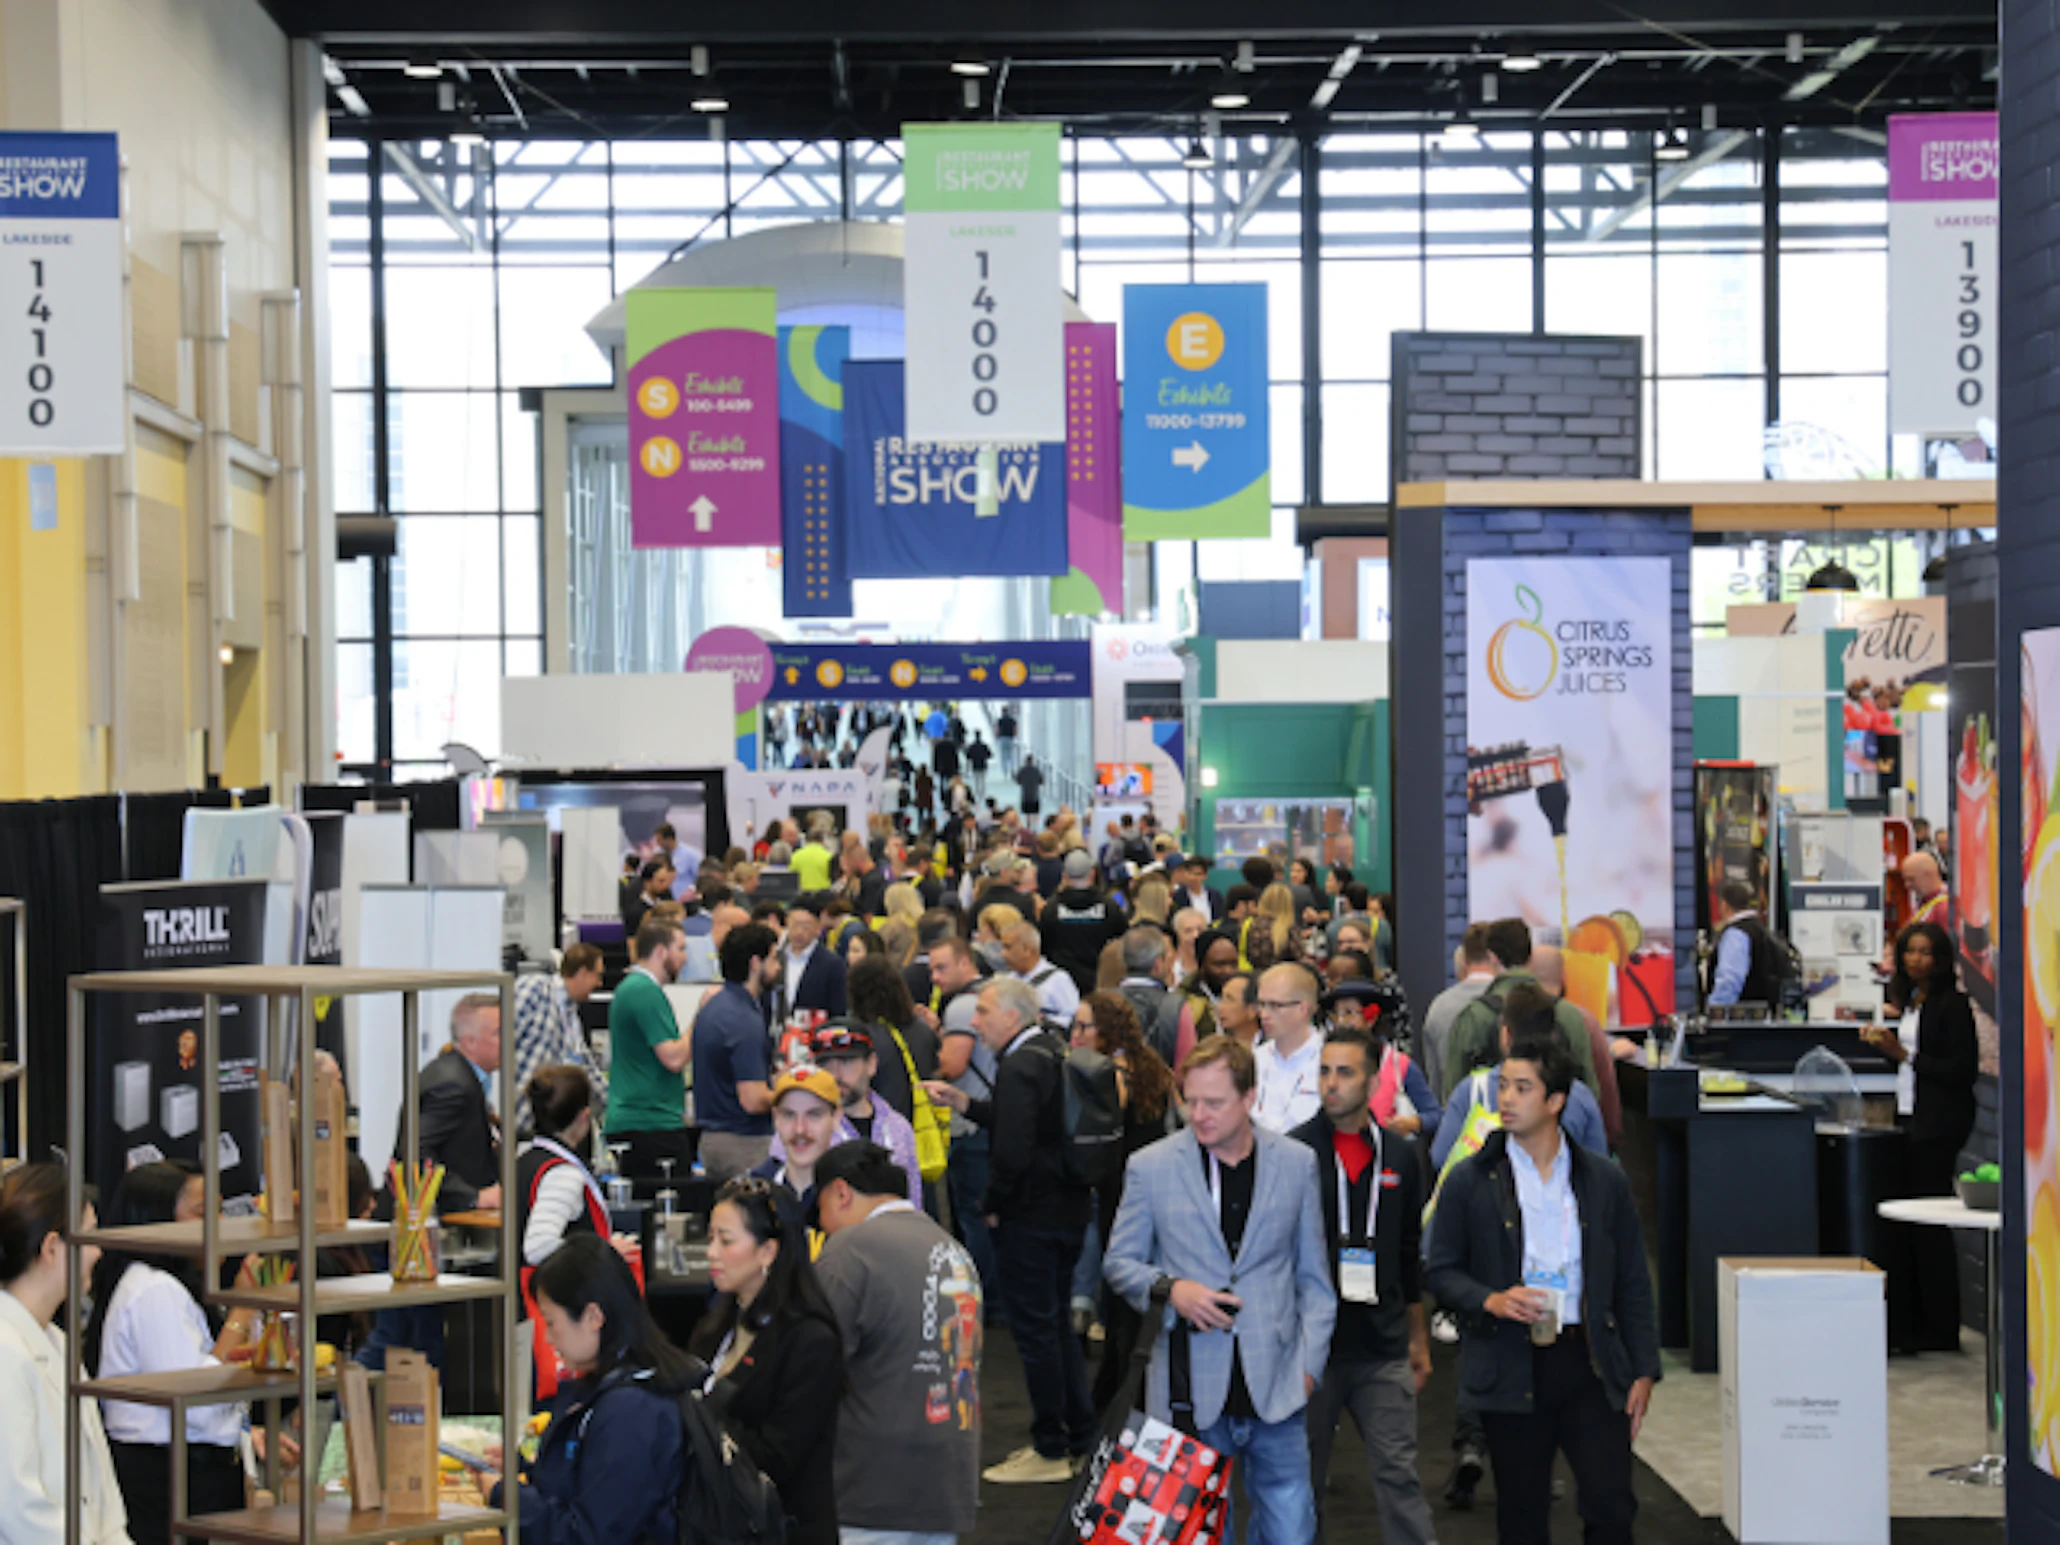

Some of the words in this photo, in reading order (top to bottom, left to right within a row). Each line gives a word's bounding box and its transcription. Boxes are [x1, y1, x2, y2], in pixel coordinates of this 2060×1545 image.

[943, 168, 1030, 192] SHOW
[3, 233, 73, 245] LAKESIDE
[948, 224, 1018, 238] LAKESIDE
[971, 250, 998, 417] 14000
[1956, 240, 1983, 407] 13900
[27, 258, 54, 428] 14100
[1181, 323, 1209, 358] E
[685, 372, 744, 394] Exhibits
[1158, 376, 1232, 407] Exhibits
[647, 384, 669, 411] S
[1146, 412, 1247, 429] 11000-13799
[688, 431, 746, 454] Exhibits
[648, 444, 674, 469] N
[889, 454, 1040, 466] ASSOCIION
[889, 464, 1040, 504] SHOW
[1556, 619, 1631, 642] CITRUS
[1563, 645, 1653, 668] SPRINGS
[1556, 671, 1627, 694] JUICES
[143, 906, 230, 946] THRILL
